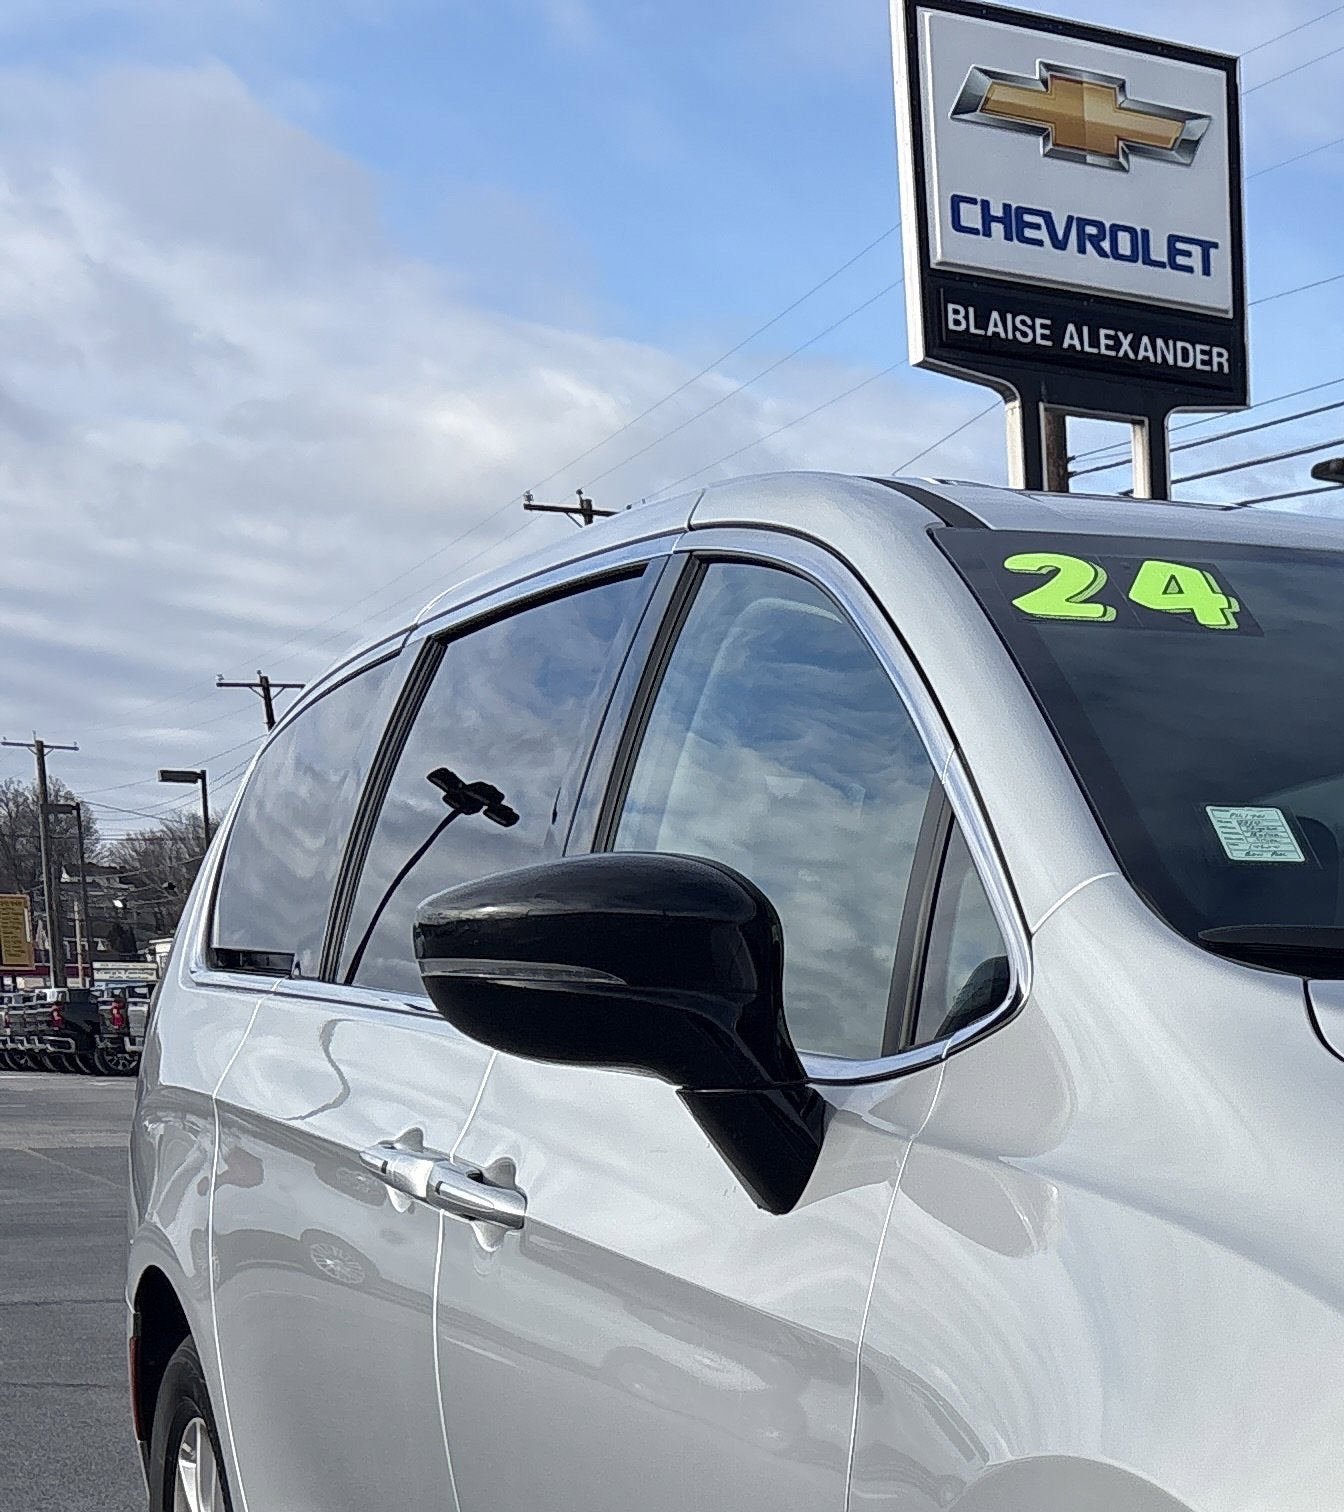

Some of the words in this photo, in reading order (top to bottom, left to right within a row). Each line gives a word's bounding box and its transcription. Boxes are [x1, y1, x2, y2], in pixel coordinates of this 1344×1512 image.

[950, 193, 1219, 277] CHEVROLET
[946, 303, 1053, 347] BLAISE
[1062, 322, 1230, 375] ALEXANDER
[1003, 553, 1241, 630] 24
